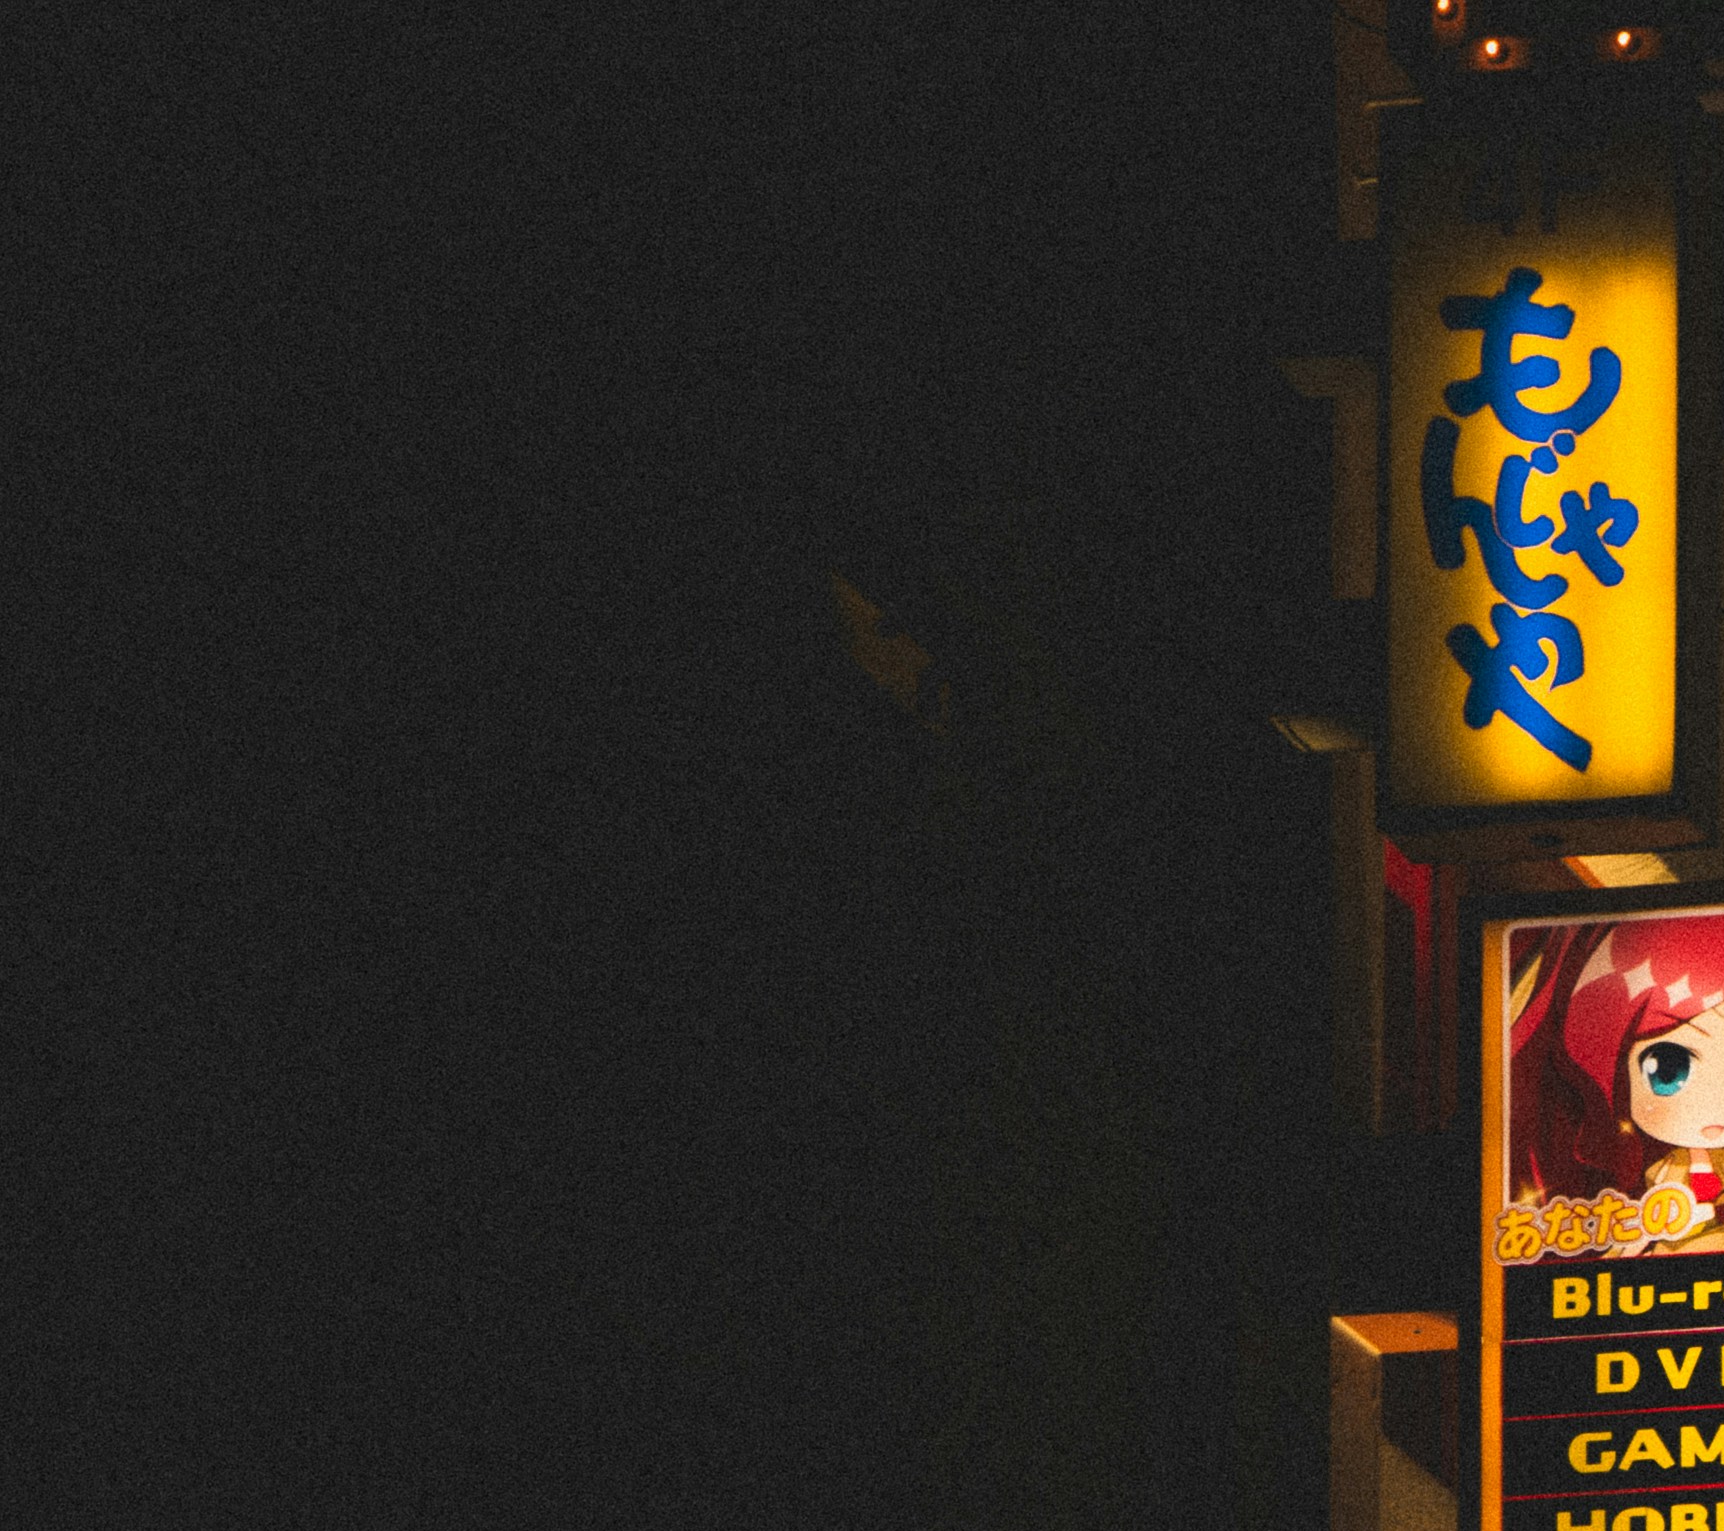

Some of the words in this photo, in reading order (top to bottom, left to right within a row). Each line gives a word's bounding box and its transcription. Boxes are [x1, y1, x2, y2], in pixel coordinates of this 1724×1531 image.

[1421, 267, 1639, 773] もんじゃや
[1495, 1184, 1697, 1265] あなたの
